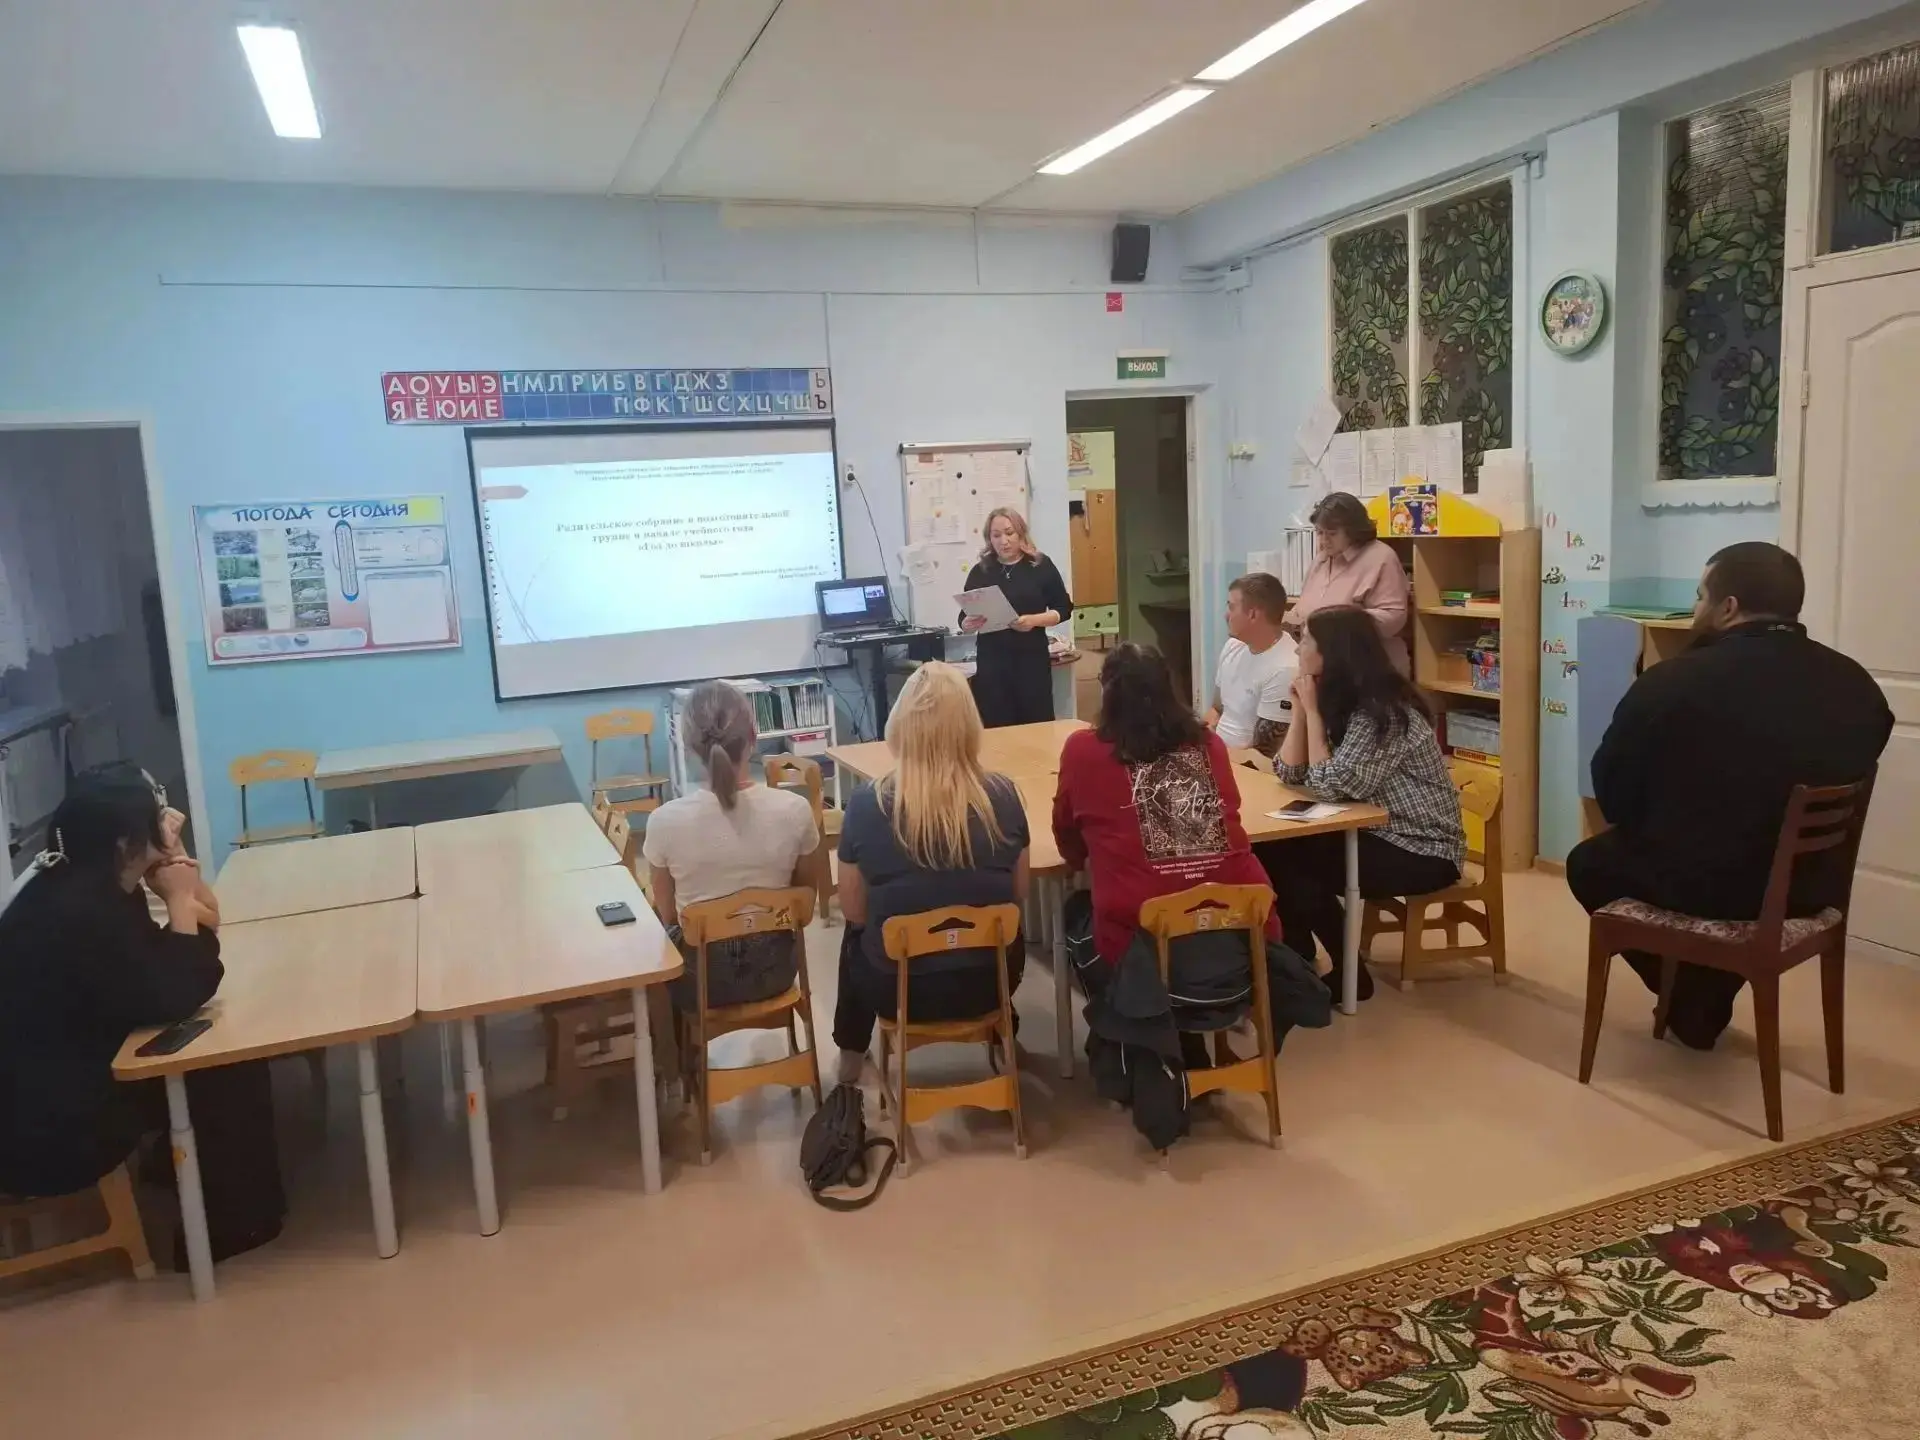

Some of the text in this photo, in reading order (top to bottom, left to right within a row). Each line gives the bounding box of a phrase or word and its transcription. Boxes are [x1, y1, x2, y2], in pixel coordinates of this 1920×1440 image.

[1127, 362, 1158, 372] ВЫХОД
[231, 502, 409, 522] ПОГОДА СЕГОДНЯ
[1588, 553, 1604, 571] 2
[1177, 781, 1226, 818] Again
